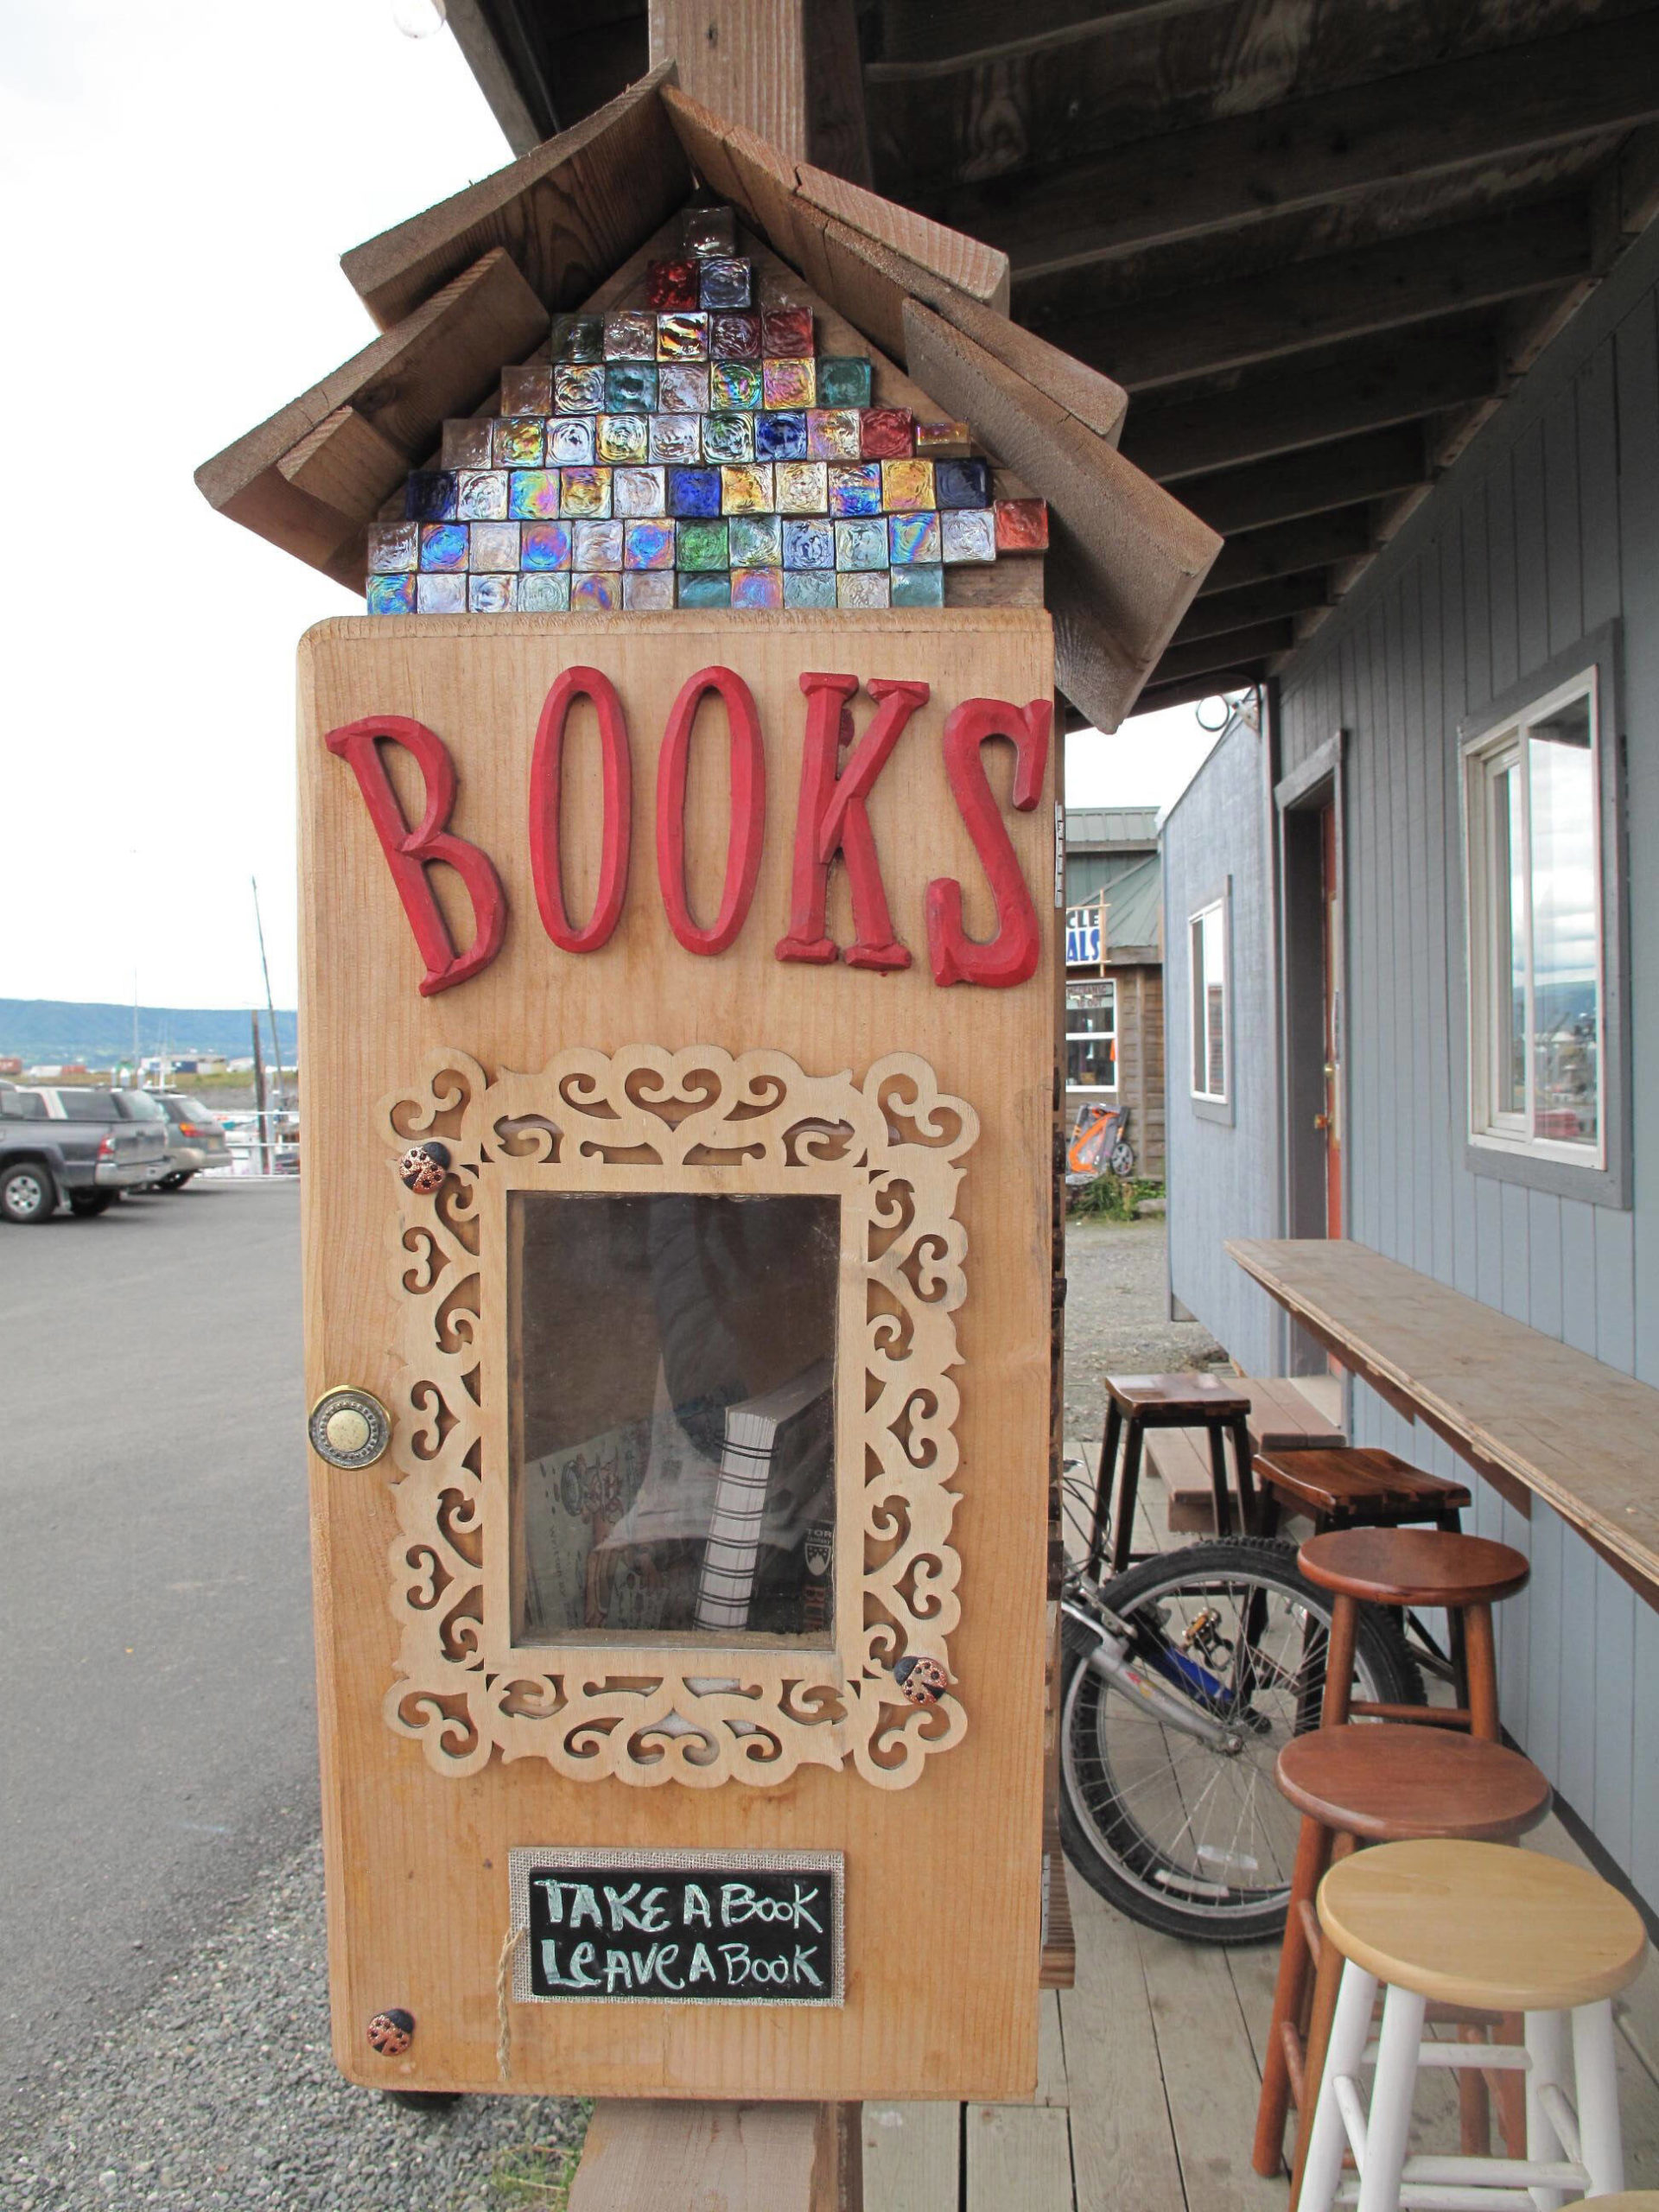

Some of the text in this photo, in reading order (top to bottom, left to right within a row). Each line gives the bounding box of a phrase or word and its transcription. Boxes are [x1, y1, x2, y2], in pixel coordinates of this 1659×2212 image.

[325, 665, 1052, 997] BOOKS
[1067, 929, 1100, 962] ALS
[807, 1528, 832, 1537] TOR
[533, 1878, 671, 1932] TAKE
[683, 1884, 712, 1928] A
[690, 1942, 716, 1983] A
